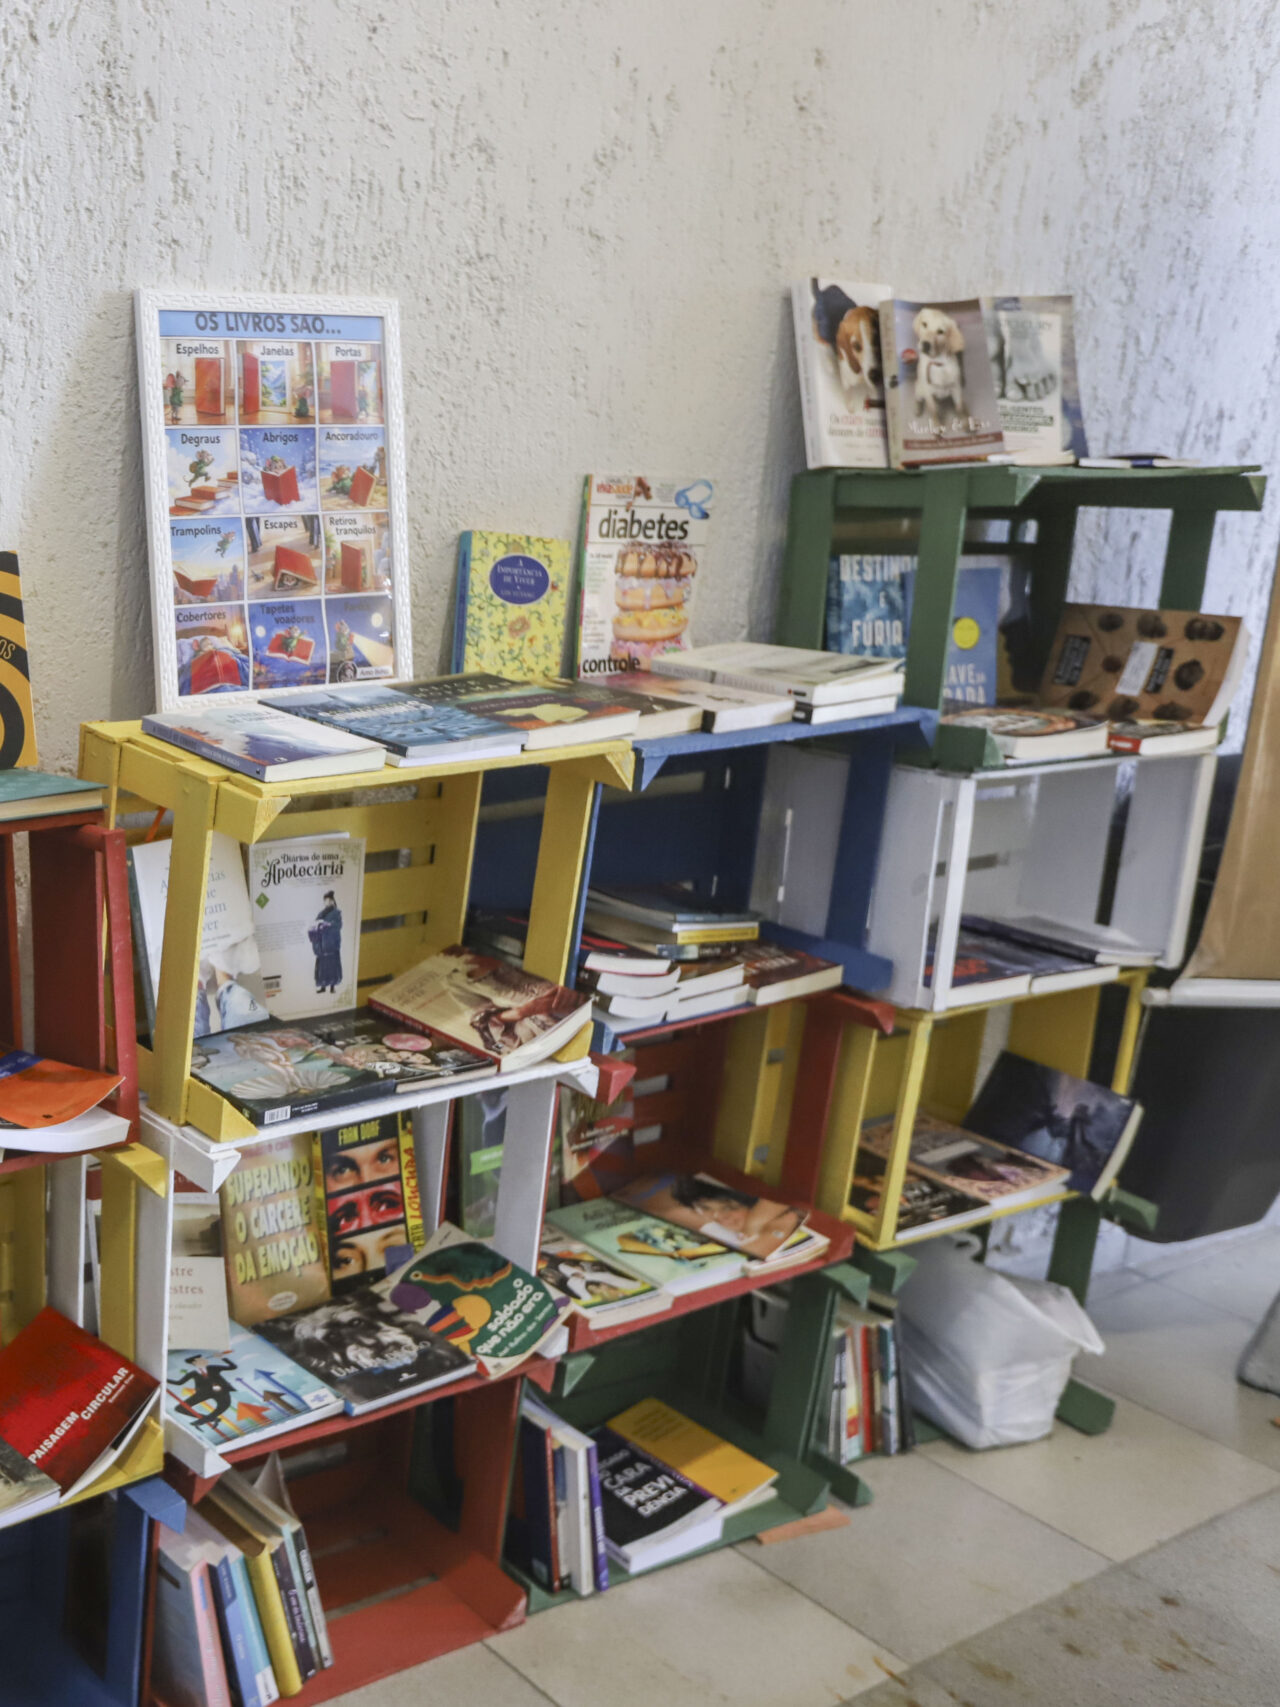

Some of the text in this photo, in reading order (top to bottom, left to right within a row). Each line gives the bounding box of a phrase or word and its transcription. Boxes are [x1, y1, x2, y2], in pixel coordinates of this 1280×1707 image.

[195, 313, 286, 333] OS LIVROS
[176, 344, 219, 355] Espelhos
[260, 346, 294, 357] Janelas
[335, 347, 362, 358] Portas
[181, 433, 221, 447] Degraus
[263, 432, 298, 445] Abrigos
[325, 431, 378, 441] Ancoradouro
[264, 520, 298, 532] Escapes
[329, 517, 357, 526] Retiros
[598, 510, 689, 540] diabetes
[170, 524, 221, 538] Trampolins
[336, 525, 376, 536] tranquilos
[260, 603, 294, 616] Tapetes
[177, 612, 226, 623] Cobertores
[274, 615, 315, 625] voadores
[583, 655, 640, 673] controle
[281, 853, 309, 864] Diários
[260, 859, 344, 887] Apotecária
[338, 1120, 380, 1146] FRAN DORF
[225, 1156, 314, 1208] SUPERANDO
[235, 1210, 247, 1244] O
[236, 1232, 320, 1285] DA EMOÇÃO
[513, 1278, 523, 1288] o
[487, 1284, 533, 1332] soldado
[476, 1292, 545, 1353] que não era
[80, 1367, 129, 1420] CIRCULAR
[27, 1411, 79, 1464] PAISAGEM
[603, 1460, 653, 1489] CARA
[625, 1476, 676, 1508] PREVI
